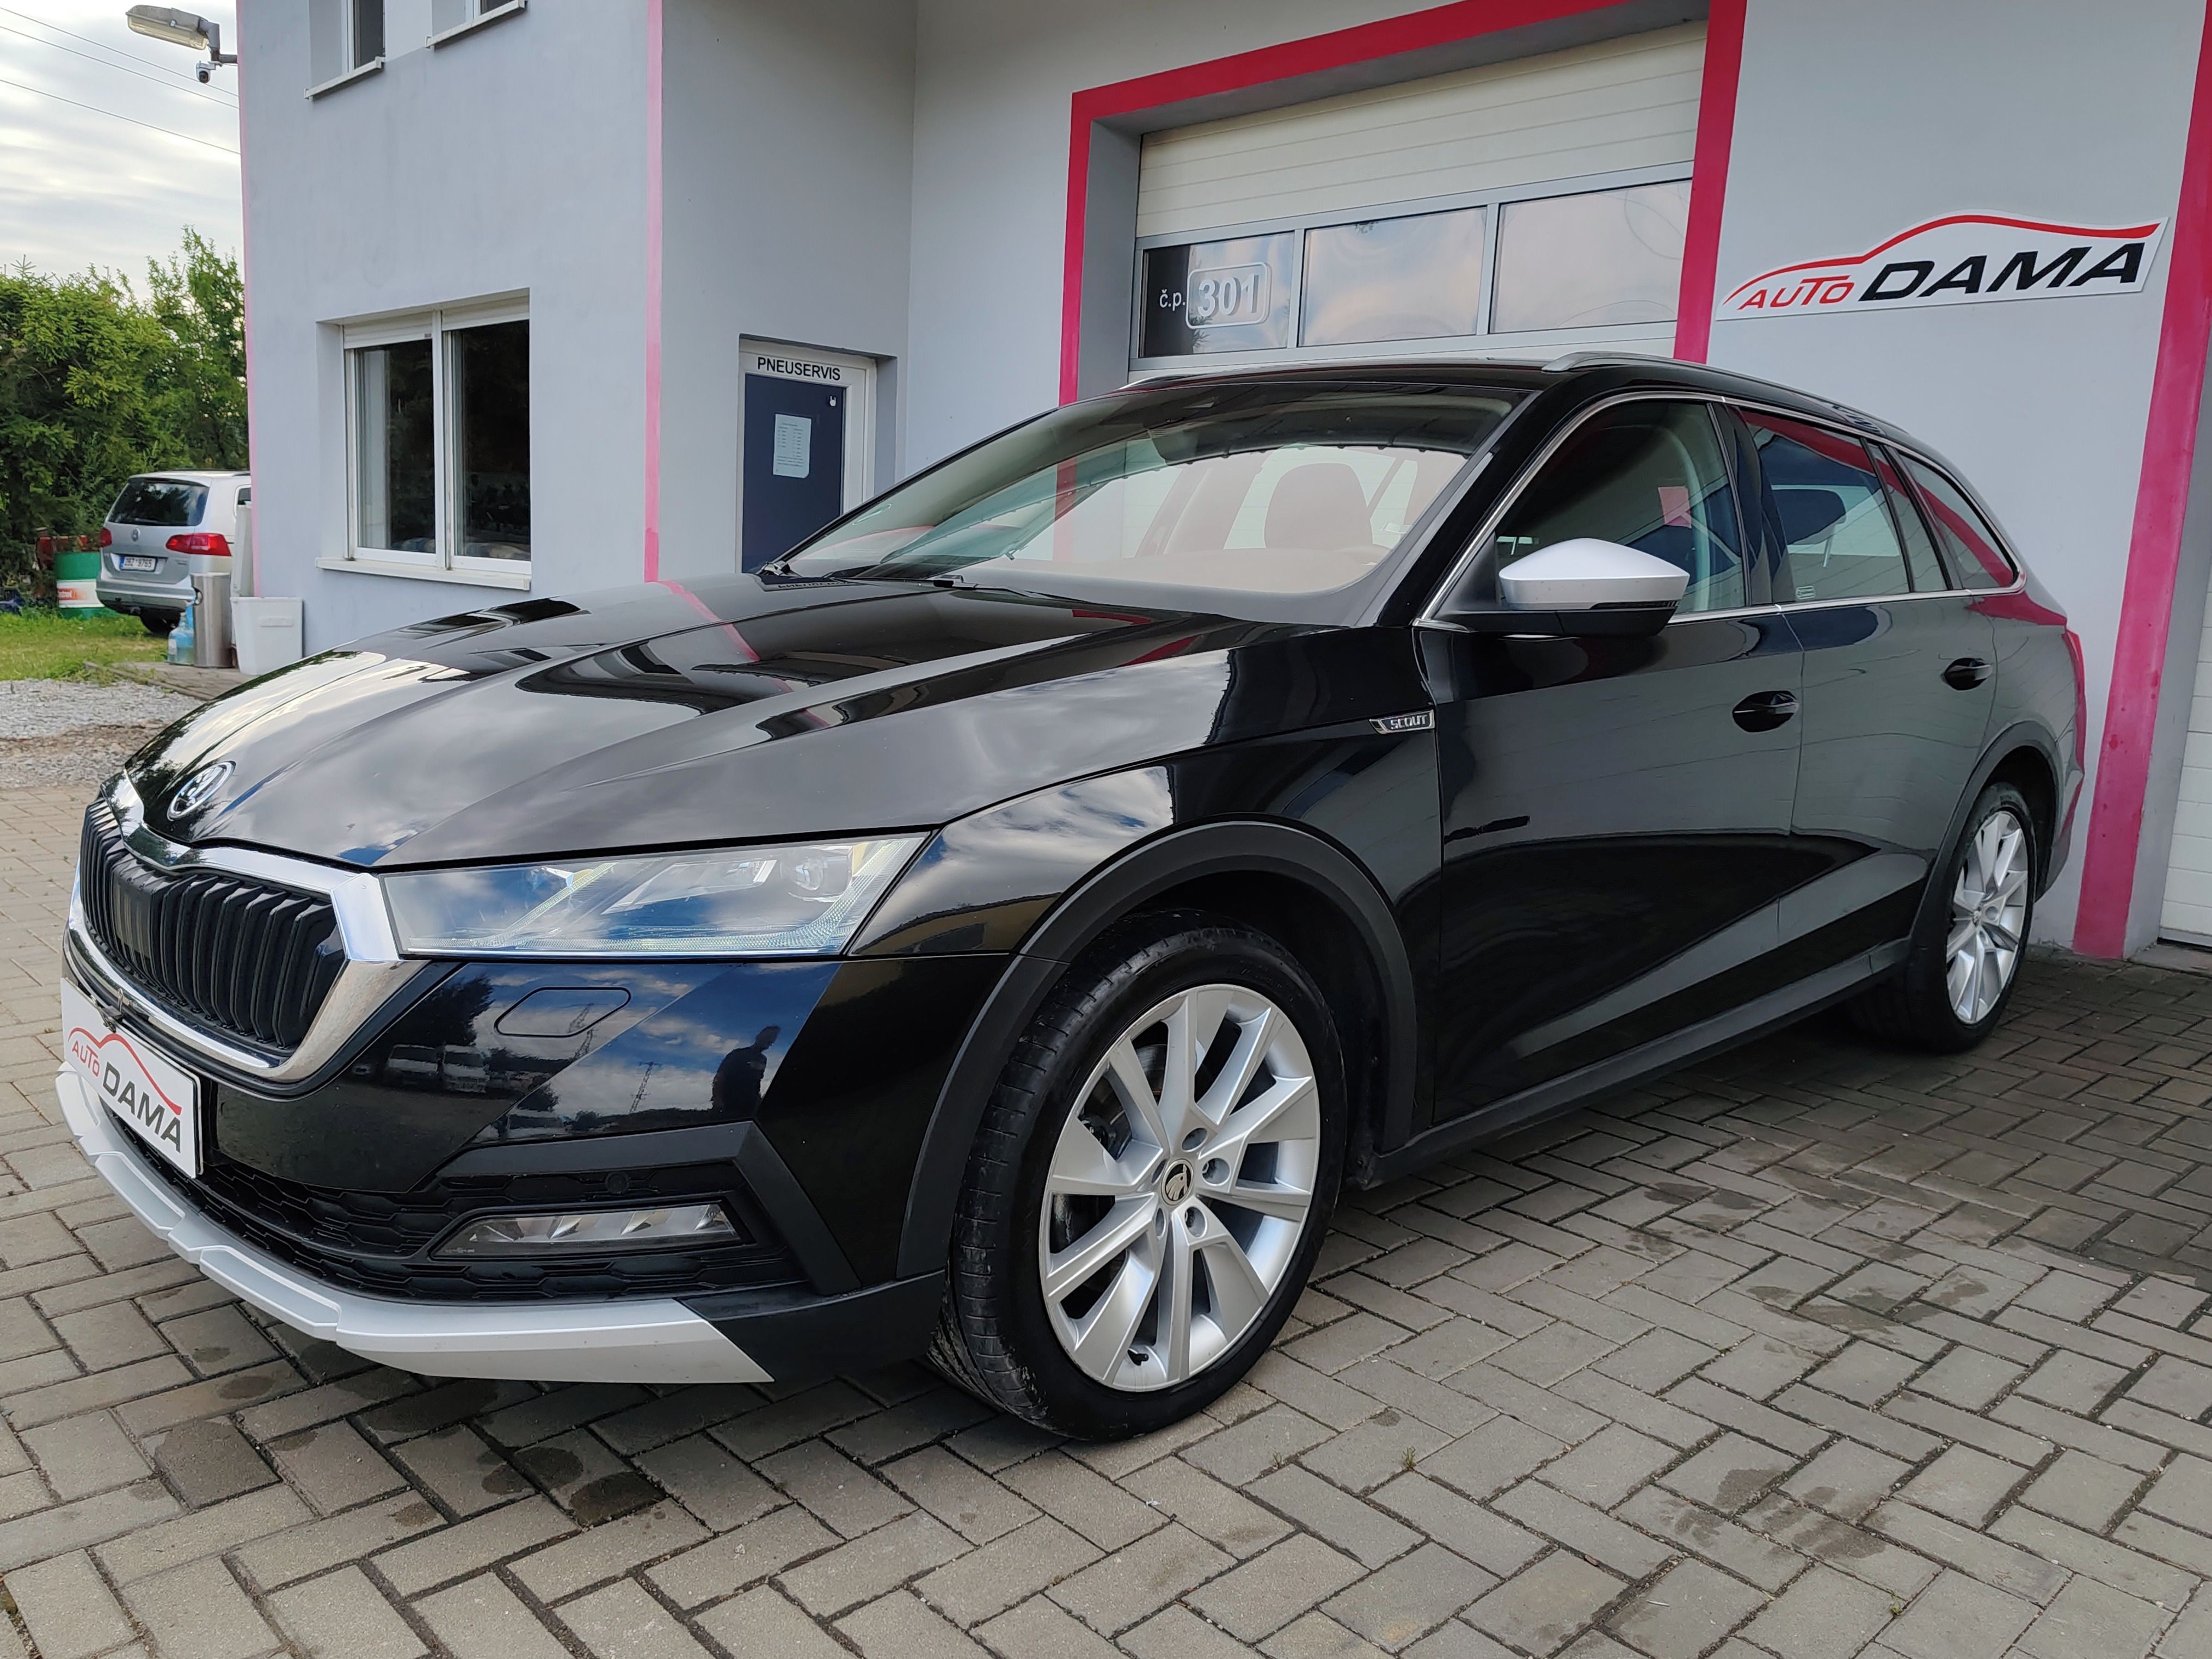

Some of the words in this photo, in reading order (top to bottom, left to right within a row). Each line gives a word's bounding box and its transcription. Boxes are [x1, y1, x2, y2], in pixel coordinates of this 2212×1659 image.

[1159, 289, 1186, 312] č.p.
[1197, 274, 1259, 318] 301
[1737, 275, 1855, 310] AUTO
[1858, 242, 2145, 302] DAMA
[757, 357, 841, 381] PNEUSERVIS
[1390, 714, 1428, 730] SCOUT
[71, 1040, 100, 1078] AUTO
[102, 1061, 181, 1154] DAMA
